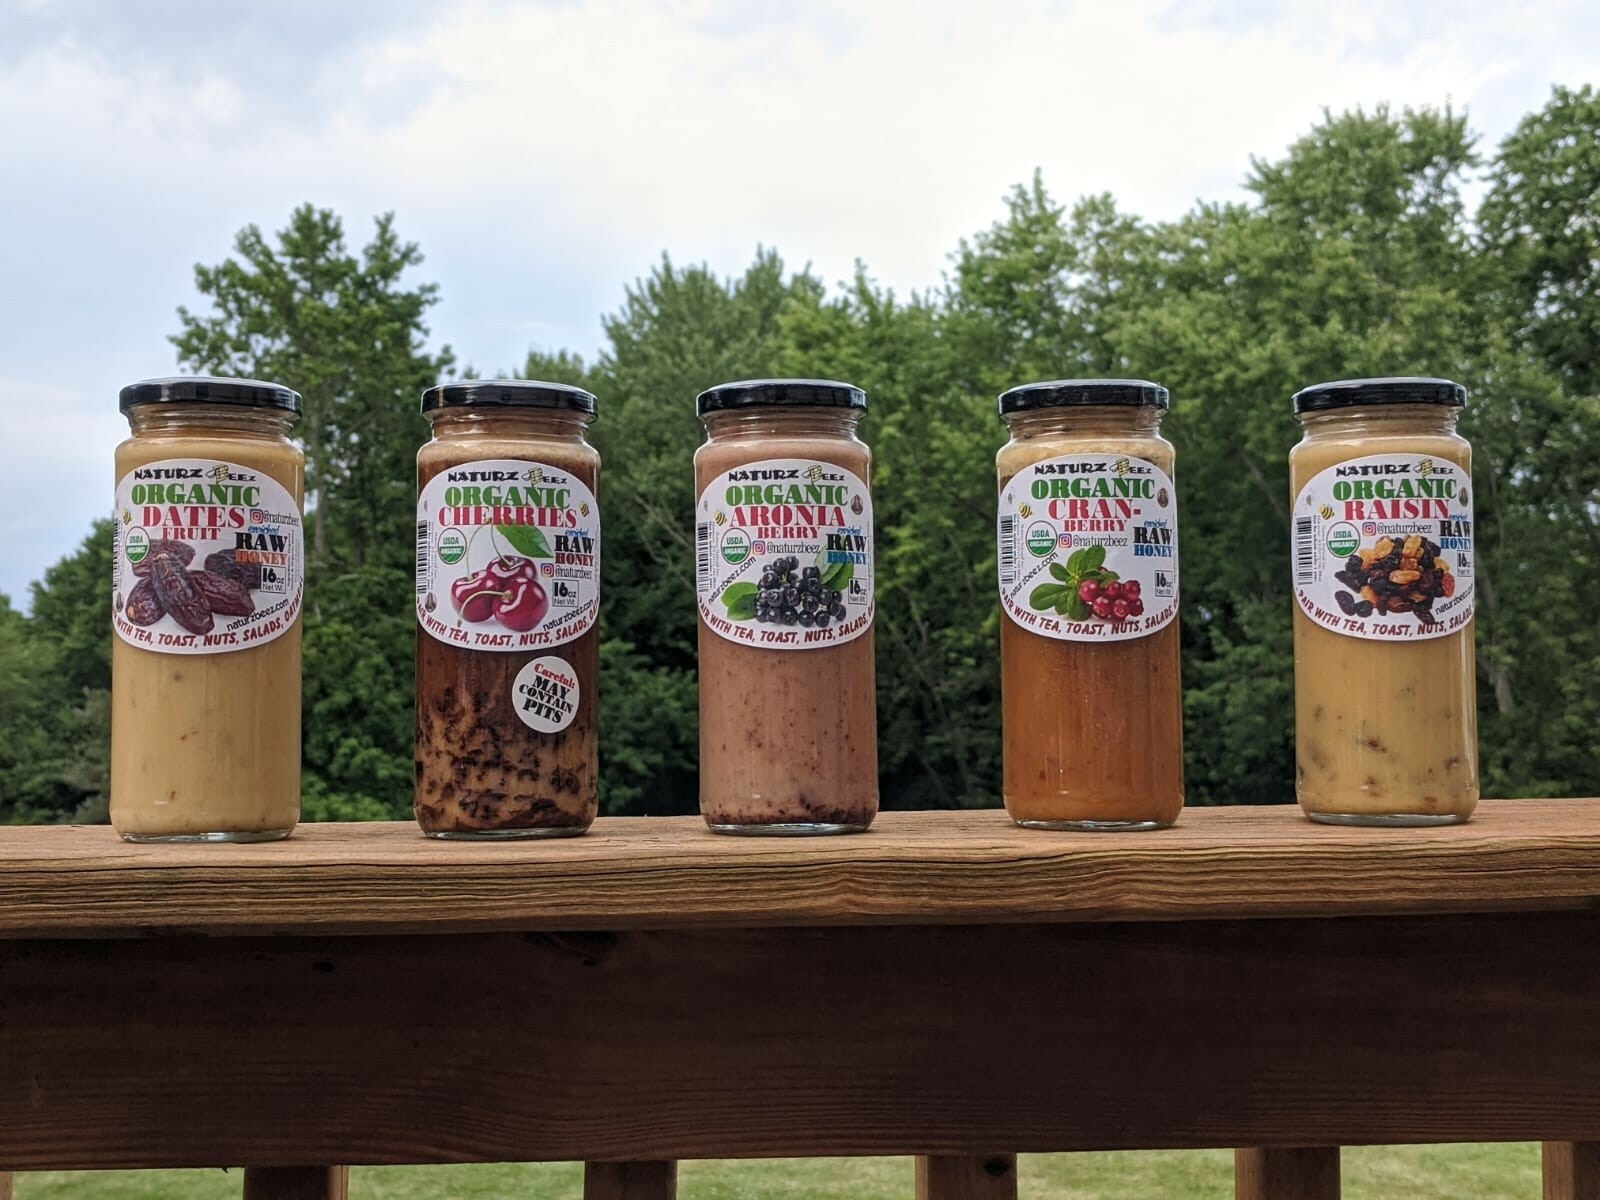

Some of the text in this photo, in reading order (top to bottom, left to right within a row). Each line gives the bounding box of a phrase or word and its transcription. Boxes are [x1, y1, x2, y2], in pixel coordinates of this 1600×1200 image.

[134, 468, 203, 481] NATURZ
[448, 471, 519, 483] NATURZ
[728, 469, 799, 482] NATURZ
[1034, 462, 1107, 476] NATURZ
[1336, 464, 1411, 477] NATURZ
[131, 483, 260, 507] ORGANIC
[444, 486, 571, 509] ORGANIC
[725, 484, 848, 506] ORGANIC
[1031, 477, 1155, 500] ORGANIC
[1333, 478, 1457, 501] ORGANIC
[142, 505, 245, 529] DATES
[438, 505, 577, 529] CHERRIES
[730, 504, 846, 527] ARONIA
[1048, 498, 1142, 520] CRAN-
[1344, 498, 1450, 521] RAISIN
[162, 528, 221, 541] FRUIT
[757, 527, 821, 539] BERRY
[1031, 529, 1050, 538] USDA
[1064, 519, 1128, 532] BERRY
[1132, 526, 1173, 545] RAW
[1333, 530, 1352, 539] USDA
[1377, 521, 1432, 535] @naturzbeez
[1439, 519, 1471, 538] RAW
[129, 535, 144, 544] USDA
[234, 531, 288, 553] RAW
[443, 536, 460, 545] USDA
[554, 534, 595, 555] RAW
[726, 536, 744, 545] USDA
[766, 540, 821, 555] @naturzbeez
[826, 533, 867, 553] RAW
[1073, 534, 1128, 548] @naturzbeez
[1440, 537, 1471, 550] HONEY
[235, 550, 288, 566] HONEY
[554, 552, 594, 567] HONEY
[826, 551, 867, 566] HONEY
[1133, 544, 1173, 558] HONEY
[708, 556, 758, 605] naturzbeez.com
[226, 598, 290, 632] naturzbeez.com
[542, 599, 594, 632] naturzbeez.com
[1014, 605, 1037, 626] WITH
[1039, 617, 1061, 634] TEA,
[1066, 622, 1107, 637] TOAST,
[1111, 620, 1143, 634] NUTS,
[1298, 590, 1314, 613] PAIR
[1314, 607, 1341, 627] WITH
[1343, 619, 1367, 635] TEA,
[1372, 623, 1413, 638] TOAST,
[1417, 620, 1447, 635] NUTS,
[116, 616, 134, 637] WITH
[134, 627, 154, 646] TEA,
[158, 633, 200, 648] TOAST,
[203, 632, 240, 646] NUTS,
[242, 616, 285, 642] SALADS,
[426, 615, 448, 636] WITH
[448, 627, 470, 645] TEA,
[475, 632, 515, 648] TOAST,
[519, 631, 553, 646] NUTS,
[710, 614, 732, 634] WITH
[734, 625, 756, 643] TEA,
[760, 630, 800, 645] TOAST,
[804, 628, 836, 643] NUTS,
[534, 663, 575, 689] Careful:
[532, 674, 571, 700] MAY
[518, 683, 574, 714] CONTAIN
[522, 697, 564, 724] PITS
